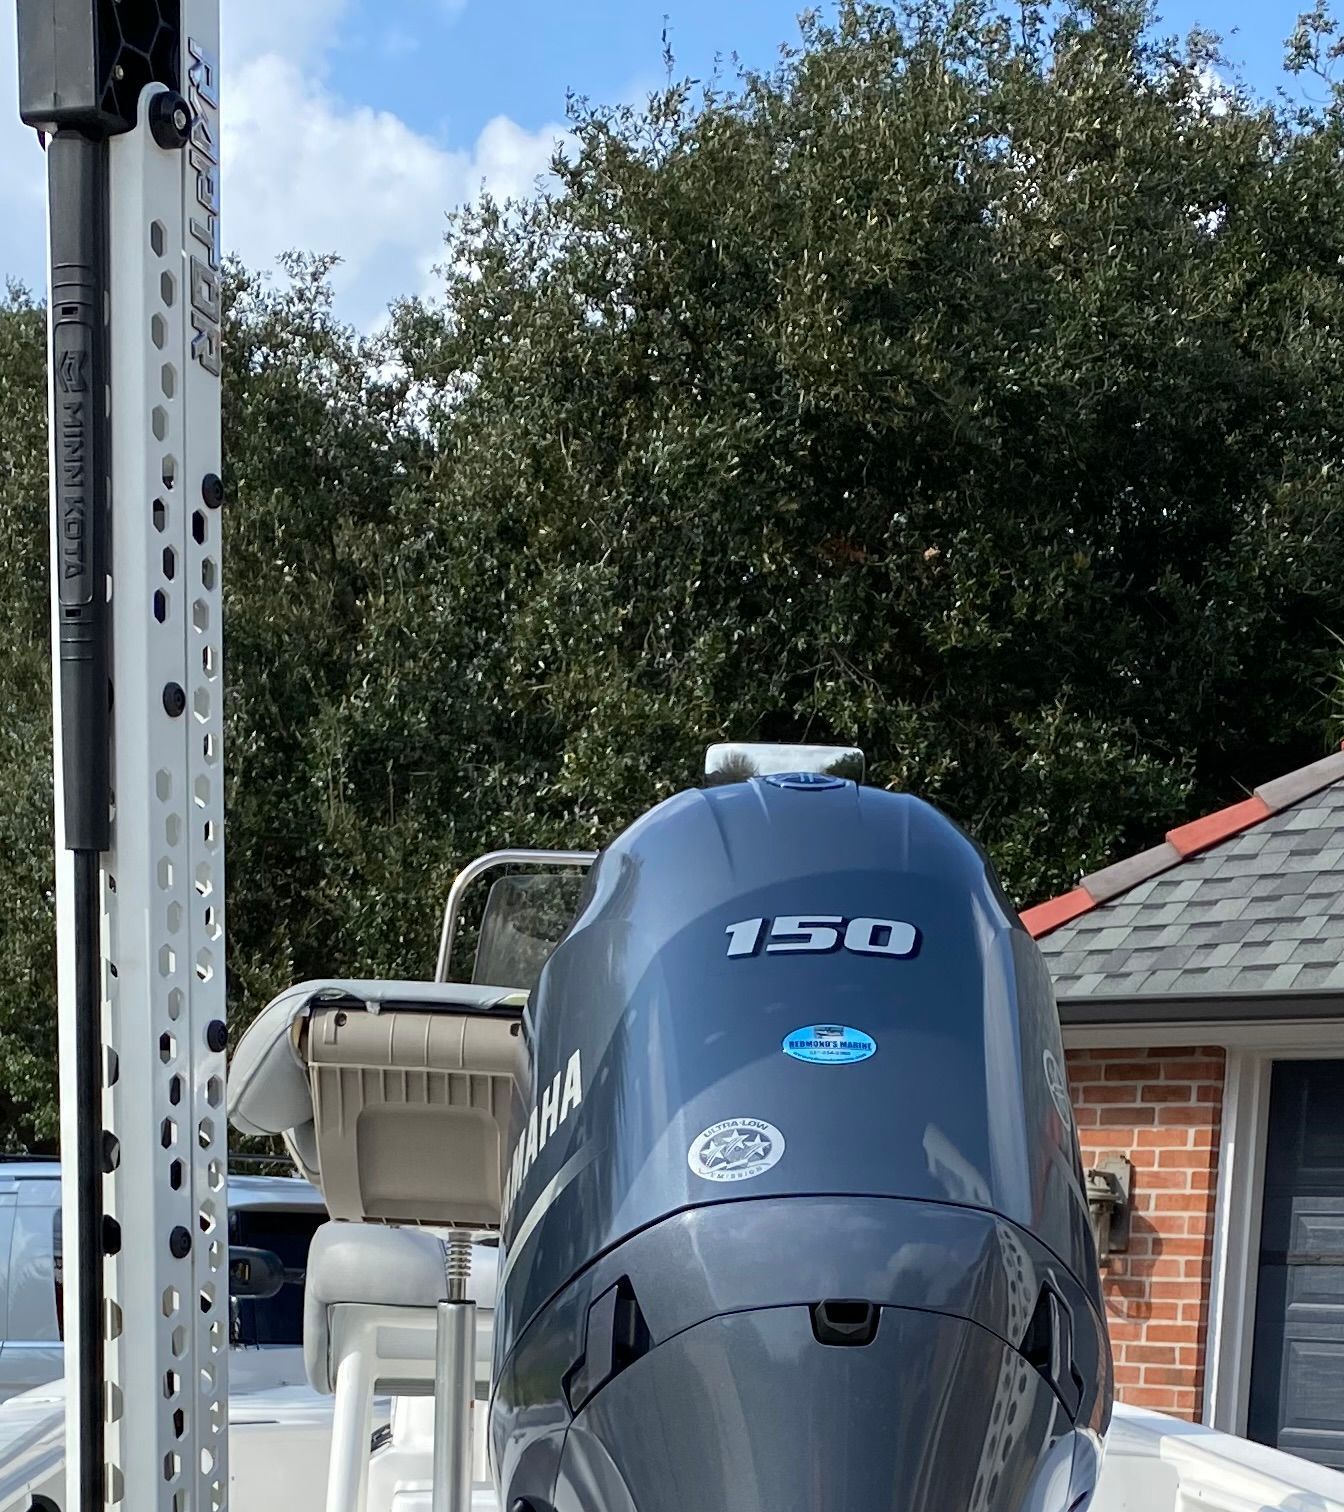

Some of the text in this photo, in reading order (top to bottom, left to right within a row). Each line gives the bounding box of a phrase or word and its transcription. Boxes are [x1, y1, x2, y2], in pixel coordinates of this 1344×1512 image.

[63, 400, 86, 580] MINN KOTA
[724, 915, 920, 958] 150
